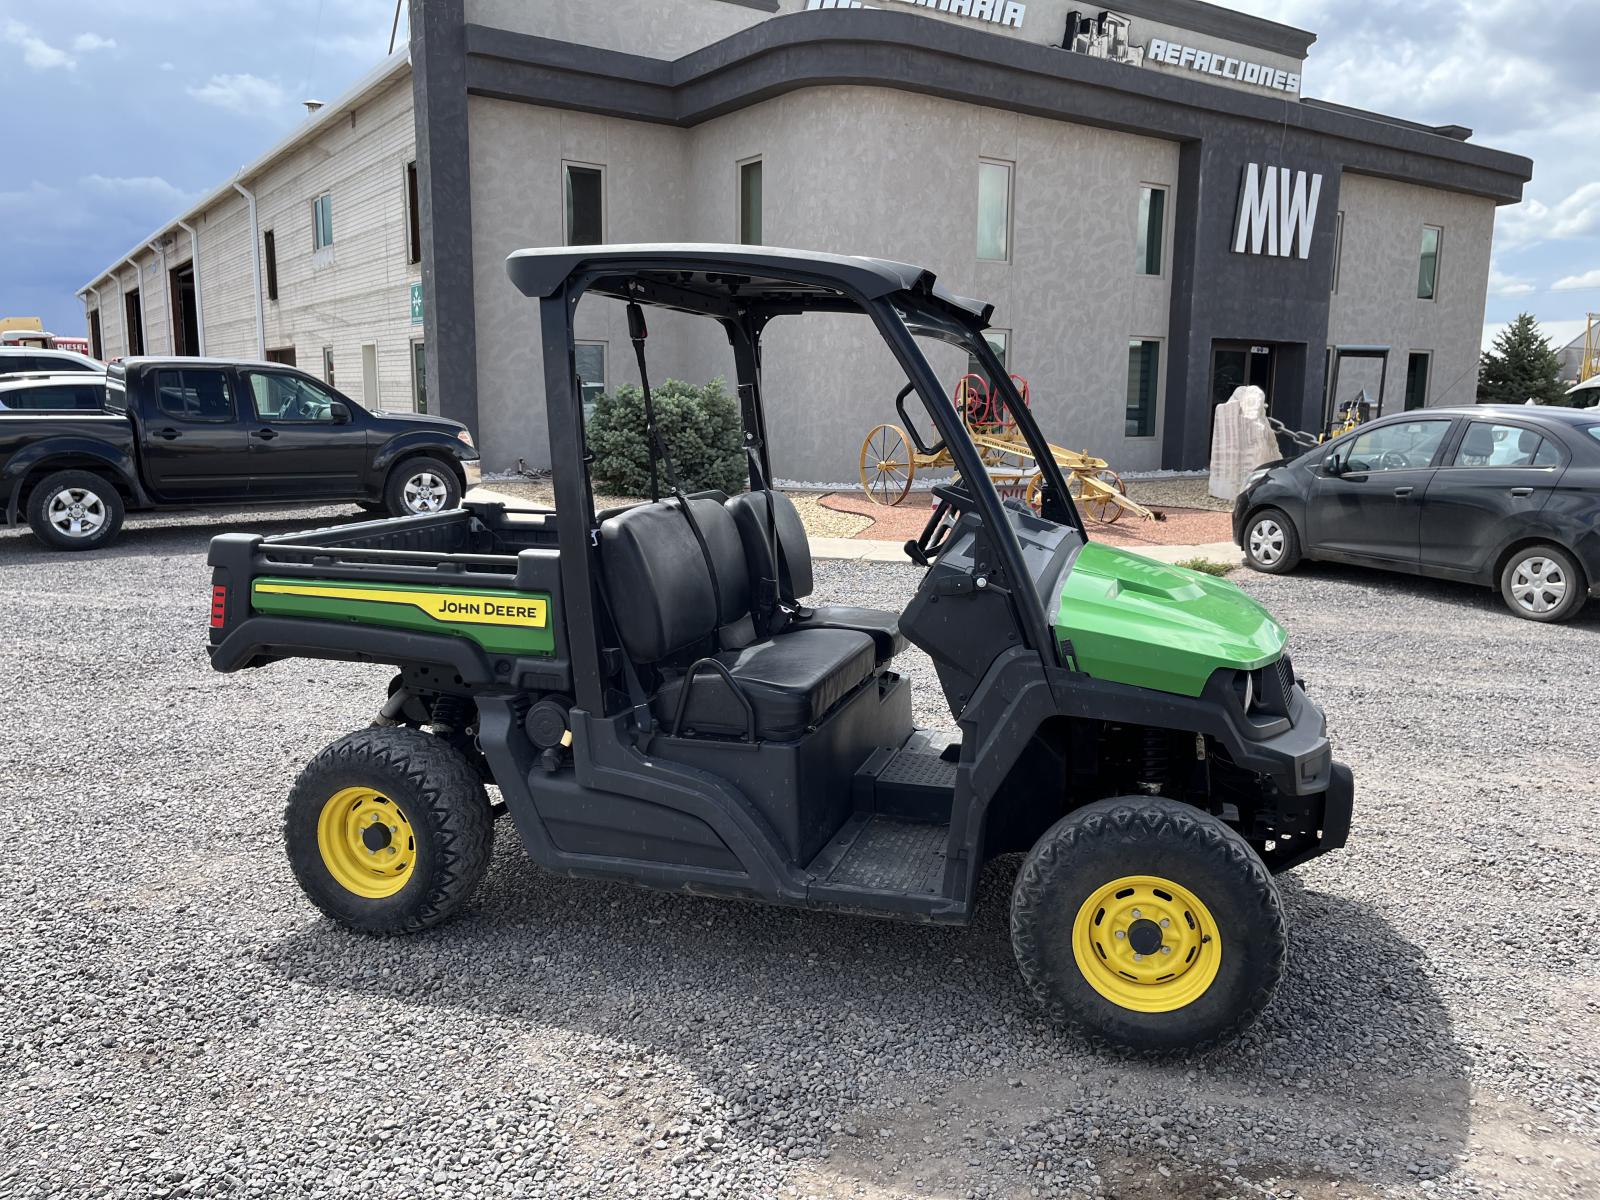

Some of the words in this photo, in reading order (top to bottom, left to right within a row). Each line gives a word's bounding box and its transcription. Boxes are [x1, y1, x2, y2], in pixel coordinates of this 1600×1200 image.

[1147, 38, 1300, 92] REFACCIONES
[1234, 162, 1323, 260] MW
[438, 599, 480, 615] JOHN
[484, 602, 537, 618] DEERE
